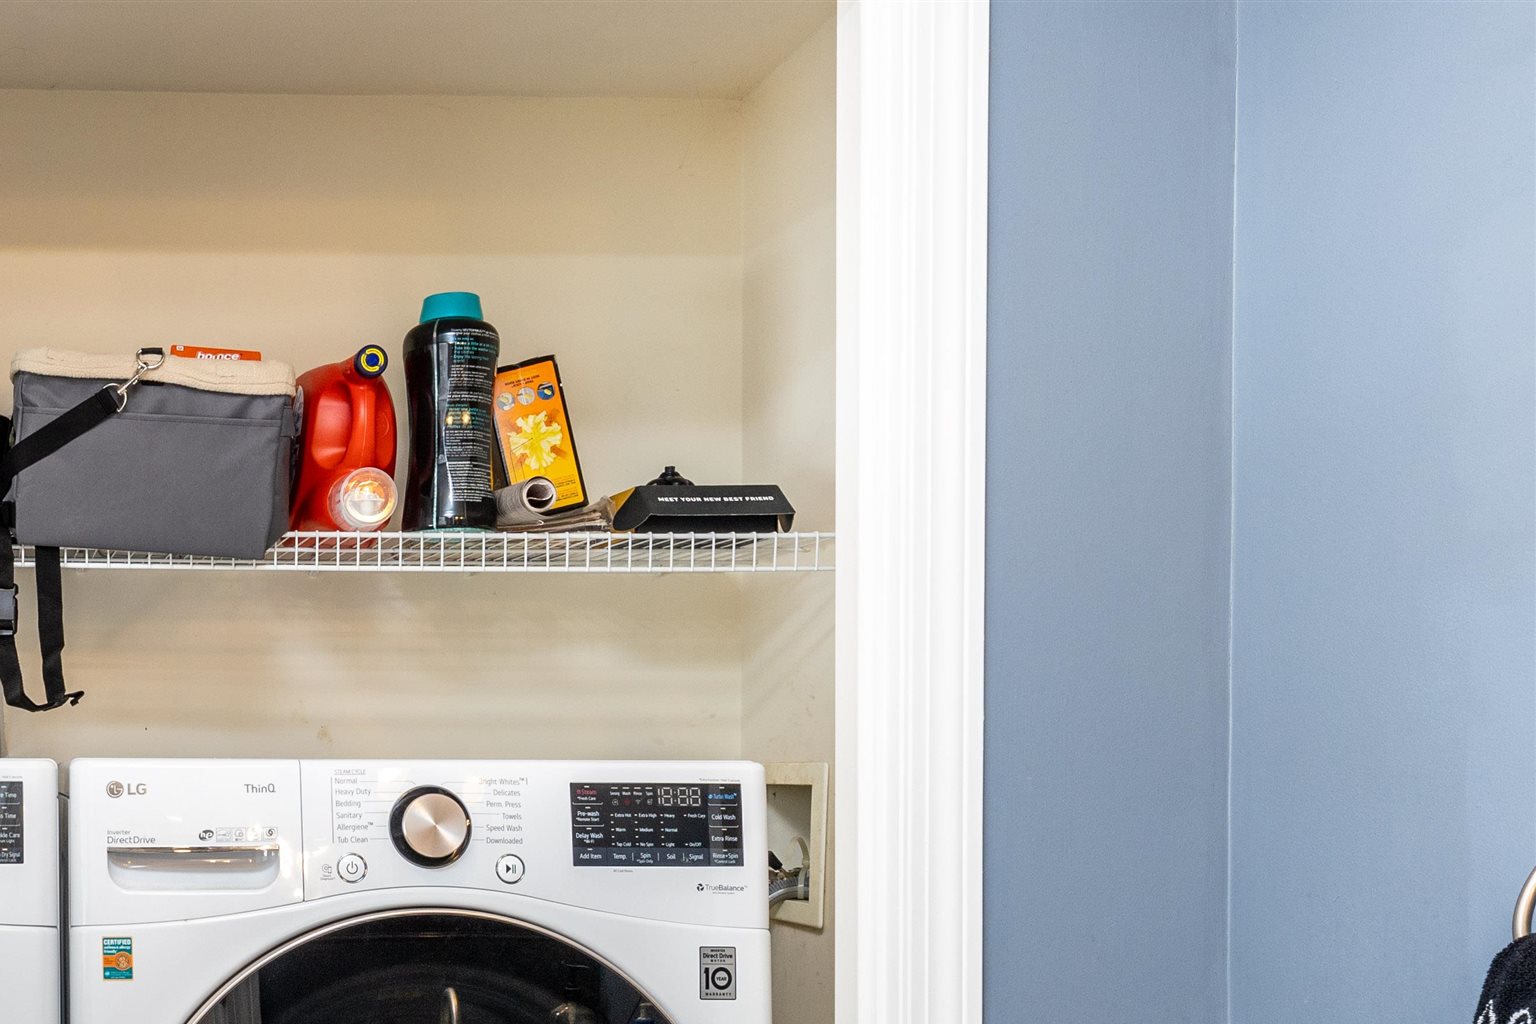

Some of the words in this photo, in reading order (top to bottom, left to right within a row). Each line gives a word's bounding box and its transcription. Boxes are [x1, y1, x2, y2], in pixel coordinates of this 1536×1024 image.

[127, 783, 147, 795] LG
[244, 783, 276, 793] ThinQ
[503, 812, 522, 820] Towels
[486, 824, 504, 832] Speed
[704, 967, 732, 990] 10
